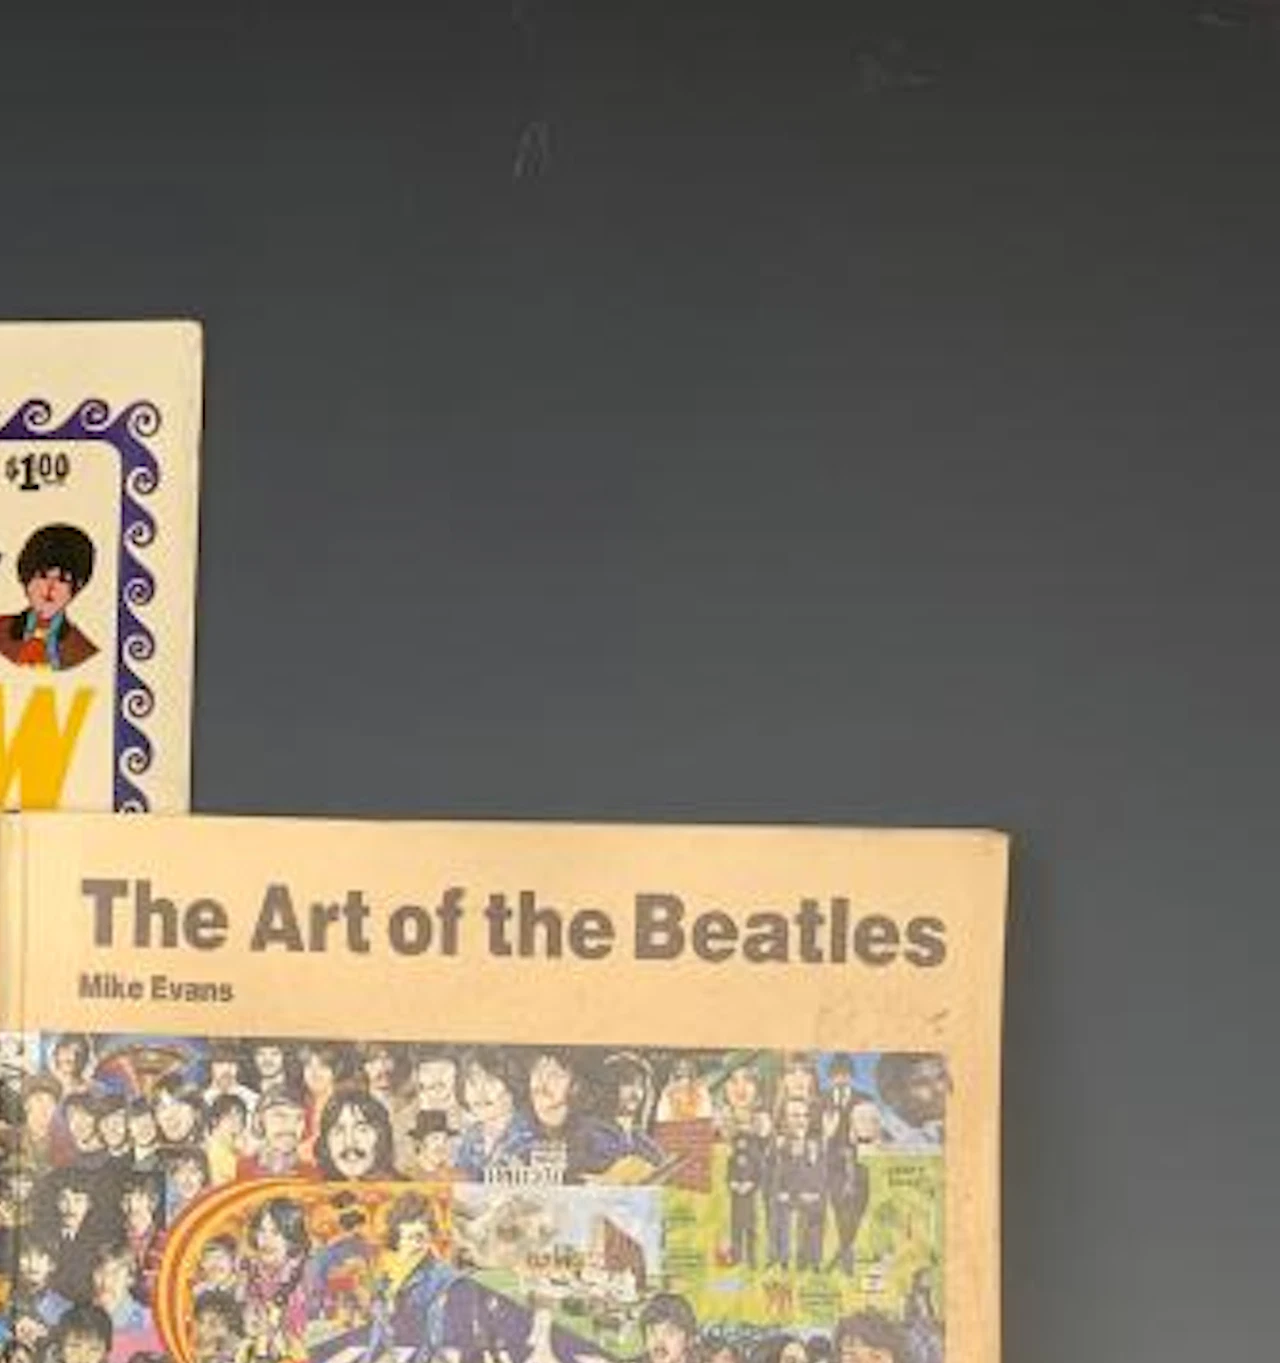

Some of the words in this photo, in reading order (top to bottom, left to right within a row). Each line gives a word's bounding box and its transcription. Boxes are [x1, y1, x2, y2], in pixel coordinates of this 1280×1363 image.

[80, 878, 230, 951] The
[250, 884, 371, 955] Art
[387, 887, 466, 956] of
[483, 890, 616, 960] the
[633, 893, 948, 969] Beatles
[78, 973, 144, 1002] Mike
[151, 975, 236, 1004] Evans
